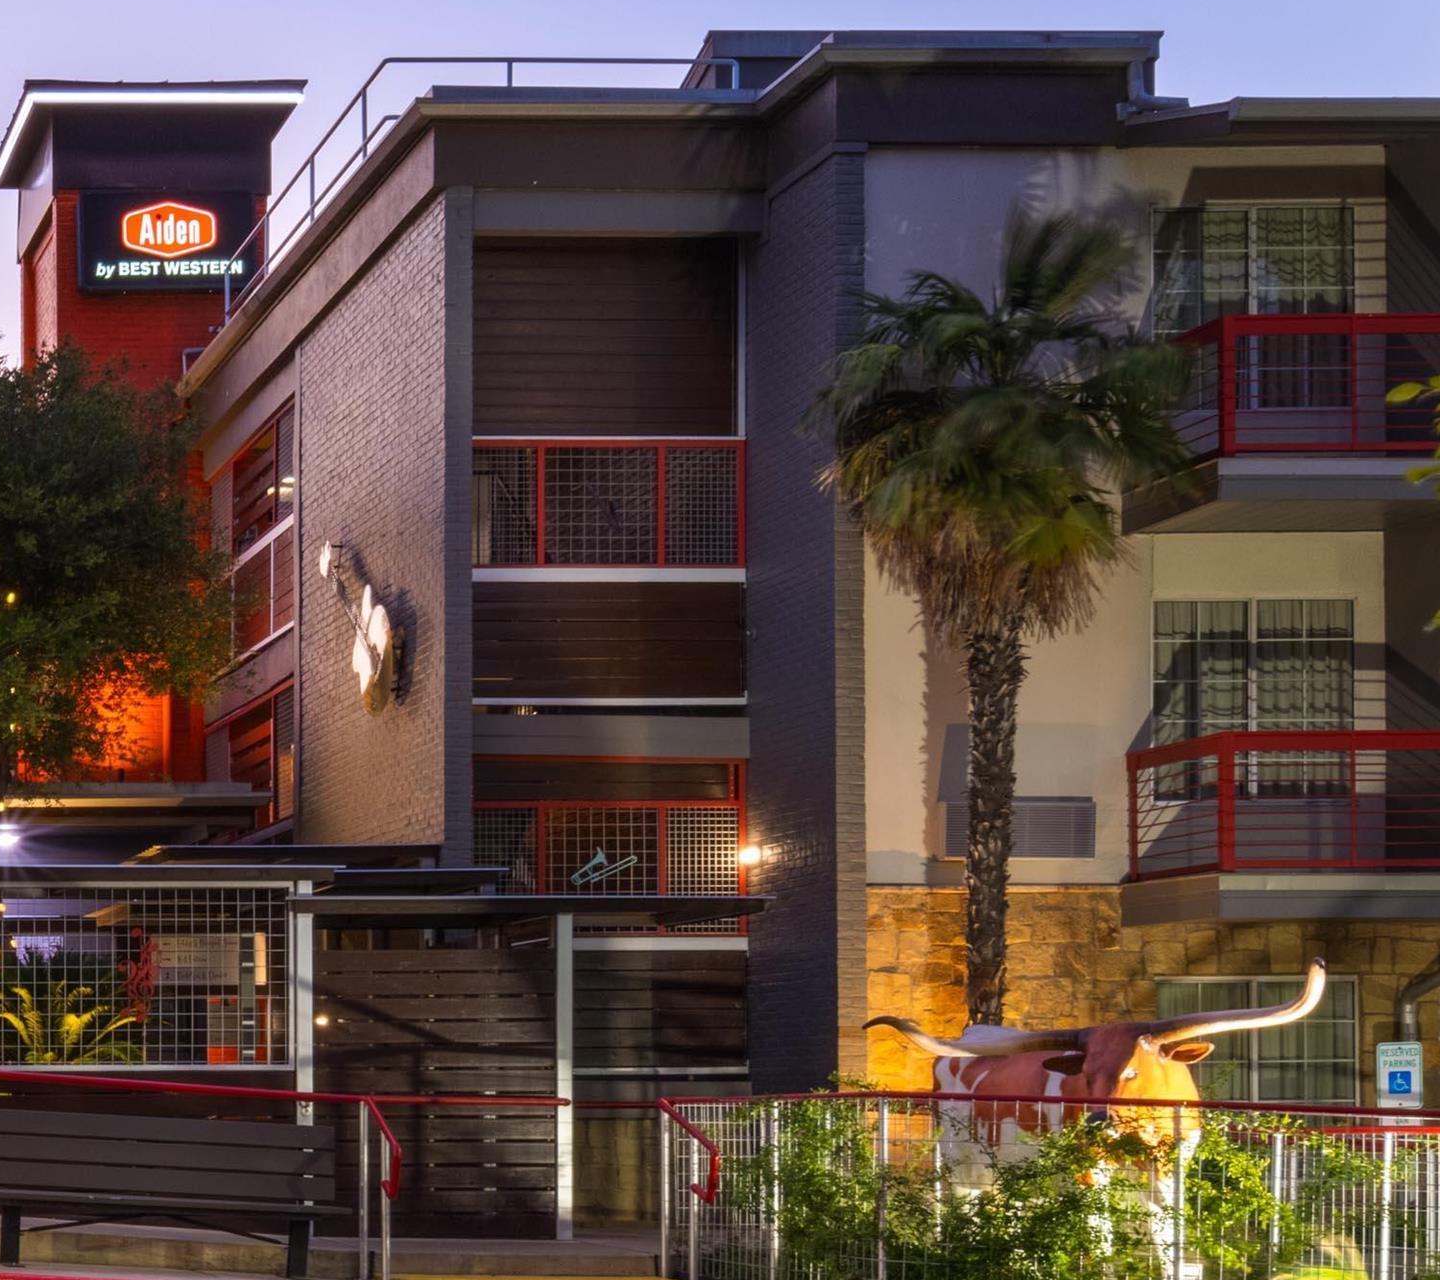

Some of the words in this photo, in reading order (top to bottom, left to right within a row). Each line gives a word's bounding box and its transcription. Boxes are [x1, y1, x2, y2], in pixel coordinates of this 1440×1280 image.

[139, 213, 201, 246] Aiden
[95, 262, 116, 279] by
[118, 261, 161, 276] BEST
[164, 260, 243, 275] WESTERN
[1380, 1047, 1420, 1057] RESERVED
[1383, 1059, 1417, 1068] PARKING
